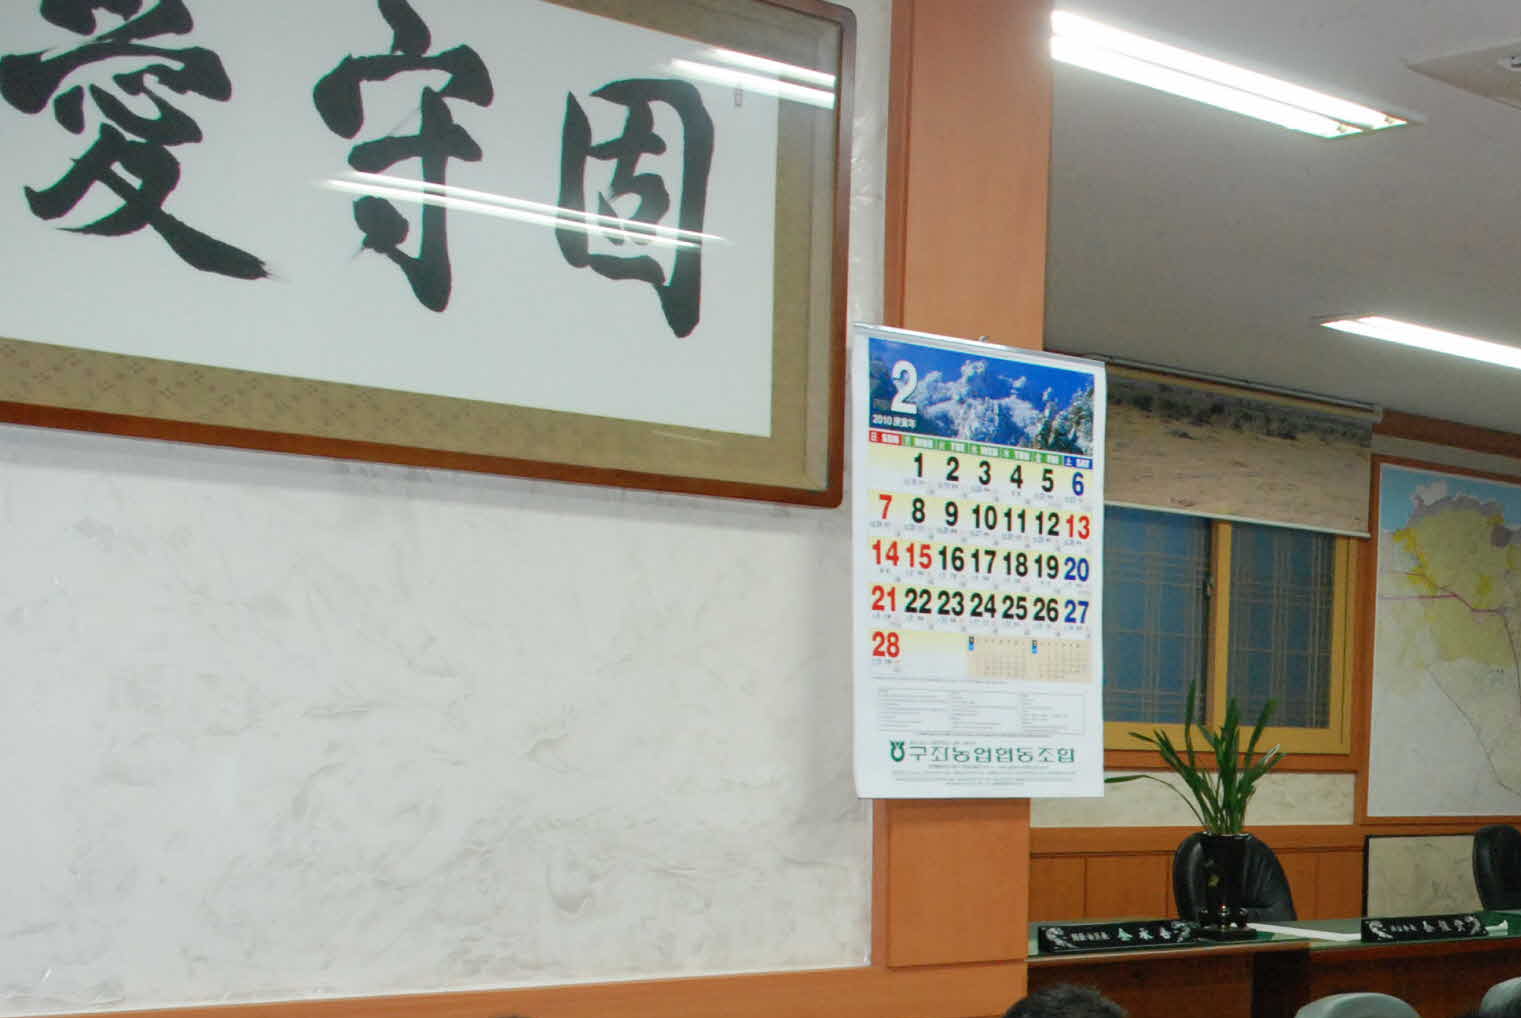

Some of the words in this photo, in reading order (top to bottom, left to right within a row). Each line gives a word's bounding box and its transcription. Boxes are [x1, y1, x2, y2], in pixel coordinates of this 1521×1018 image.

[890, 359, 918, 414] 2
[872, 413, 892, 426] 2010
[914, 452, 923, 478] 1
[946, 455, 960, 482] 2
[978, 460, 991, 486] 3
[1009, 464, 1024, 489] 4
[1041, 468, 1054, 493] 5
[1071, 471, 1084, 497] 6
[879, 493, 893, 519] 7
[911, 497, 926, 524] 8
[945, 500, 959, 527] 9
[972, 504, 998, 531] 10
[1003, 507, 1026, 533] 11
[1035, 510, 1060, 537] 12
[1066, 514, 1090, 540] 13
[872, 539, 900, 566] 14
[906, 542, 932, 569] 15
[938, 545, 965, 572] 16
[971, 548, 997, 574] 17
[1003, 551, 1029, 577] 18
[1034, 554, 1059, 580] 19
[1063, 556, 1090, 582] 20
[871, 585, 896, 612] 21
[904, 587, 932, 614] 22
[937, 589, 965, 617] 23
[970, 592, 997, 619] 24
[1001, 594, 1028, 621] 25
[1033, 596, 1059, 623] 26
[1064, 599, 1089, 624] 27
[872, 631, 900, 658] 28
